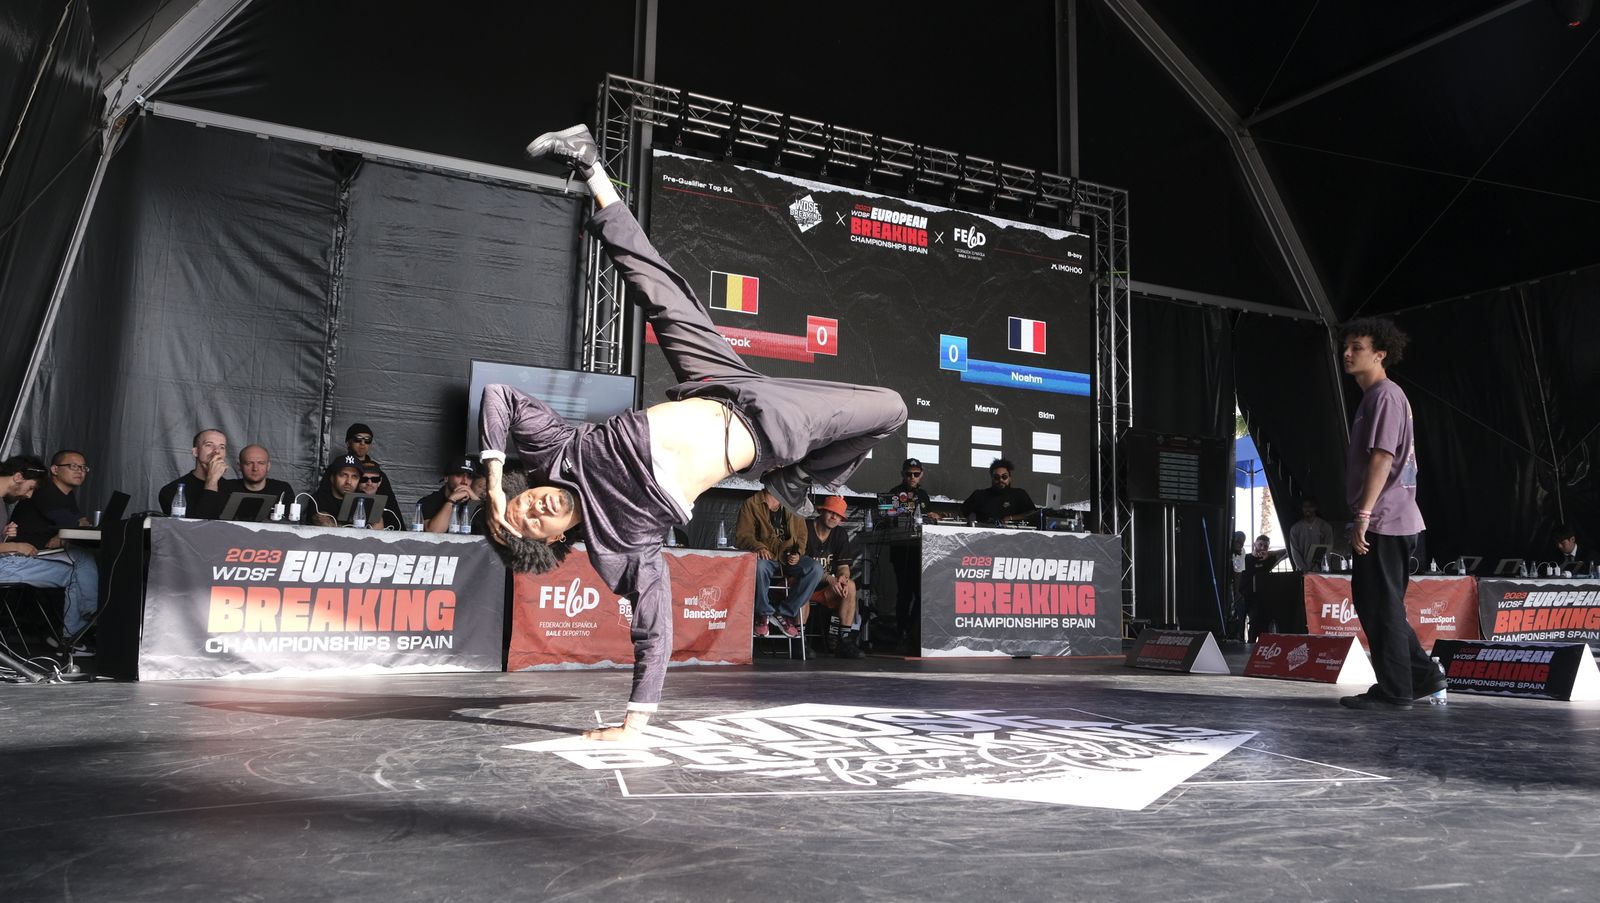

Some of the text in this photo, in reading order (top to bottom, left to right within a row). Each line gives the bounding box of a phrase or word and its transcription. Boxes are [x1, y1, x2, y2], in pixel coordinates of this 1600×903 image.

[663, 174, 707, 189] Pre-Qualifier
[708, 183, 722, 192] Top
[870, 207, 928, 229] EUROPEAN
[850, 216, 928, 247] BREAKING
[850, 235, 928, 255] CHAMPIONSHIPS SPAIN
[816, 326, 828, 346] 0
[948, 344, 959, 363] 0
[1011, 371, 1043, 385] Noahm
[916, 397, 931, 407] Fox
[974, 404, 999, 415] Manny
[224, 547, 282, 564] 2023
[961, 556, 992, 567] 2023
[211, 550, 459, 585] WDSF EUROPEAN
[954, 557, 1095, 582] WDSF EUROPEAN
[954, 581, 1096, 615] BREAKING
[1497, 600, 1524, 609] WDSF
[206, 586, 457, 633] BREAKING
[683, 608, 728, 620] DanceSport
[539, 620, 597, 629] FEDERACIÓN ESPAÑOLA
[955, 617, 1096, 629] CHAMPIONSHIPS SPAIN
[1420, 615, 1456, 625] DanceSport
[1493, 607, 1600, 634] BREAKING
[205, 635, 453, 653] CHAMPIONSHIPS SPAIN
[1491, 630, 1600, 642] CHAMPIONSHIPS SPAIN
[1476, 648, 1555, 663] EUROPEAN
[1447, 661, 1552, 682] BREAKING
[1445, 677, 1546, 690] CHAMPIONSHIPS SPAIN
